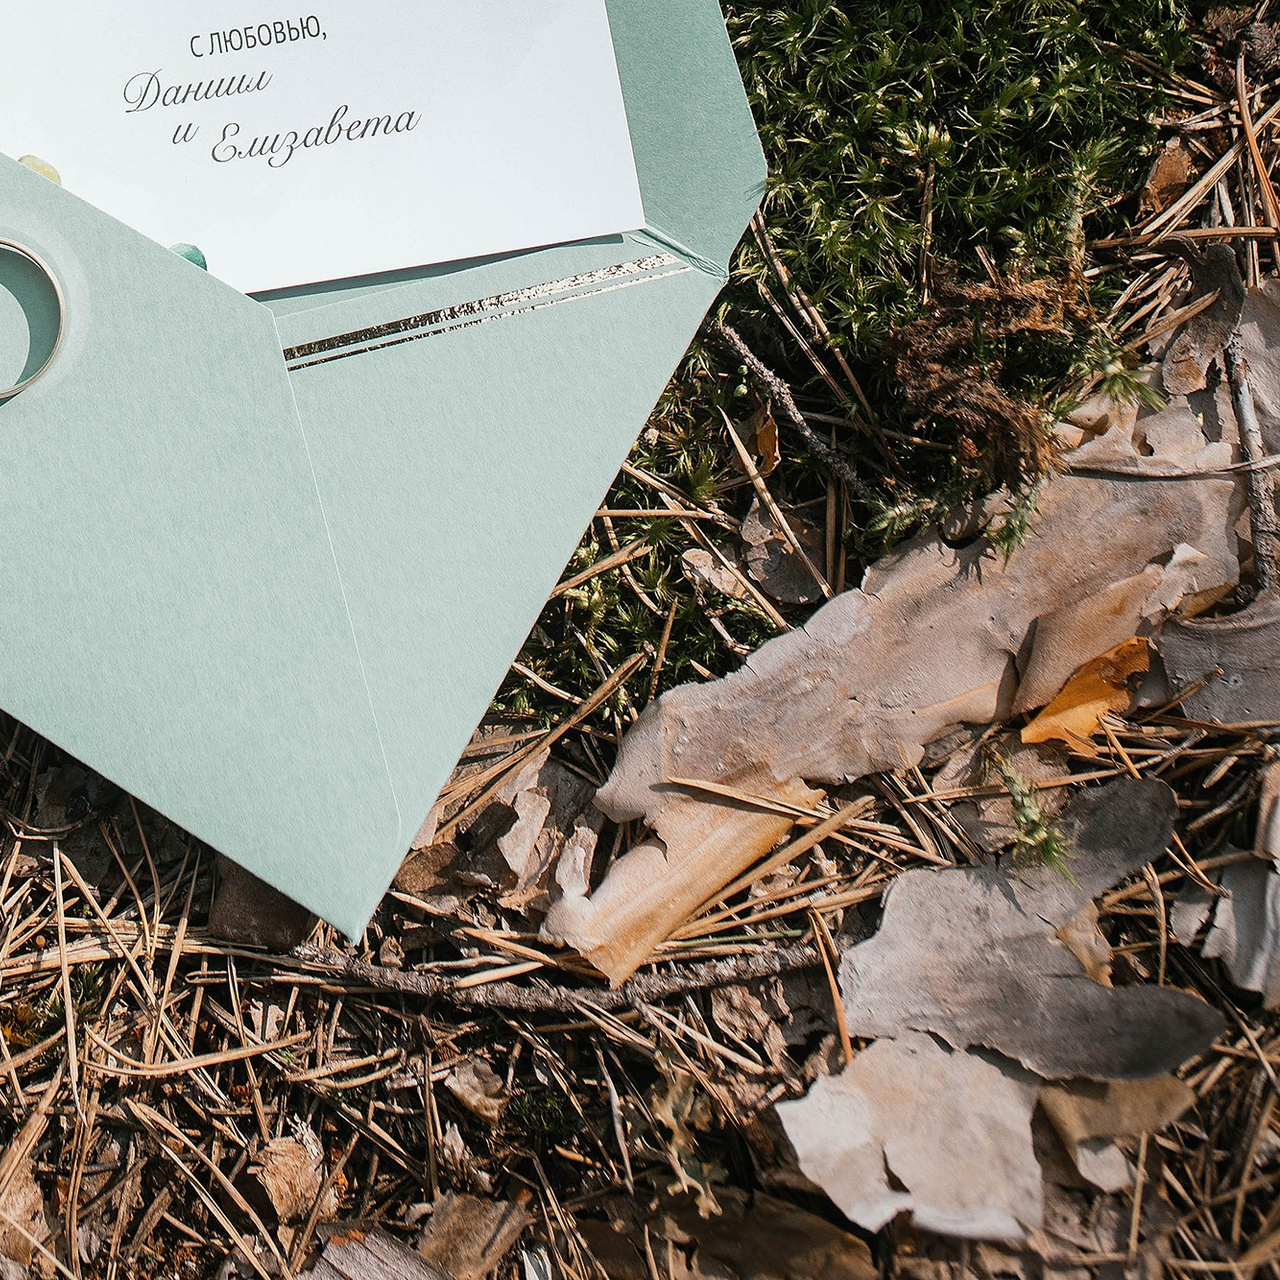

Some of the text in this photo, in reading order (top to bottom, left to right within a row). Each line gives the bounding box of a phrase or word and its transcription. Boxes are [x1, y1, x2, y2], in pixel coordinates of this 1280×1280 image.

[190, 15, 326, 57] С ЛЮБОВЬЮ,
[124, 69, 273, 113] Даниил
[172, 105, 422, 168] и Елизавета
